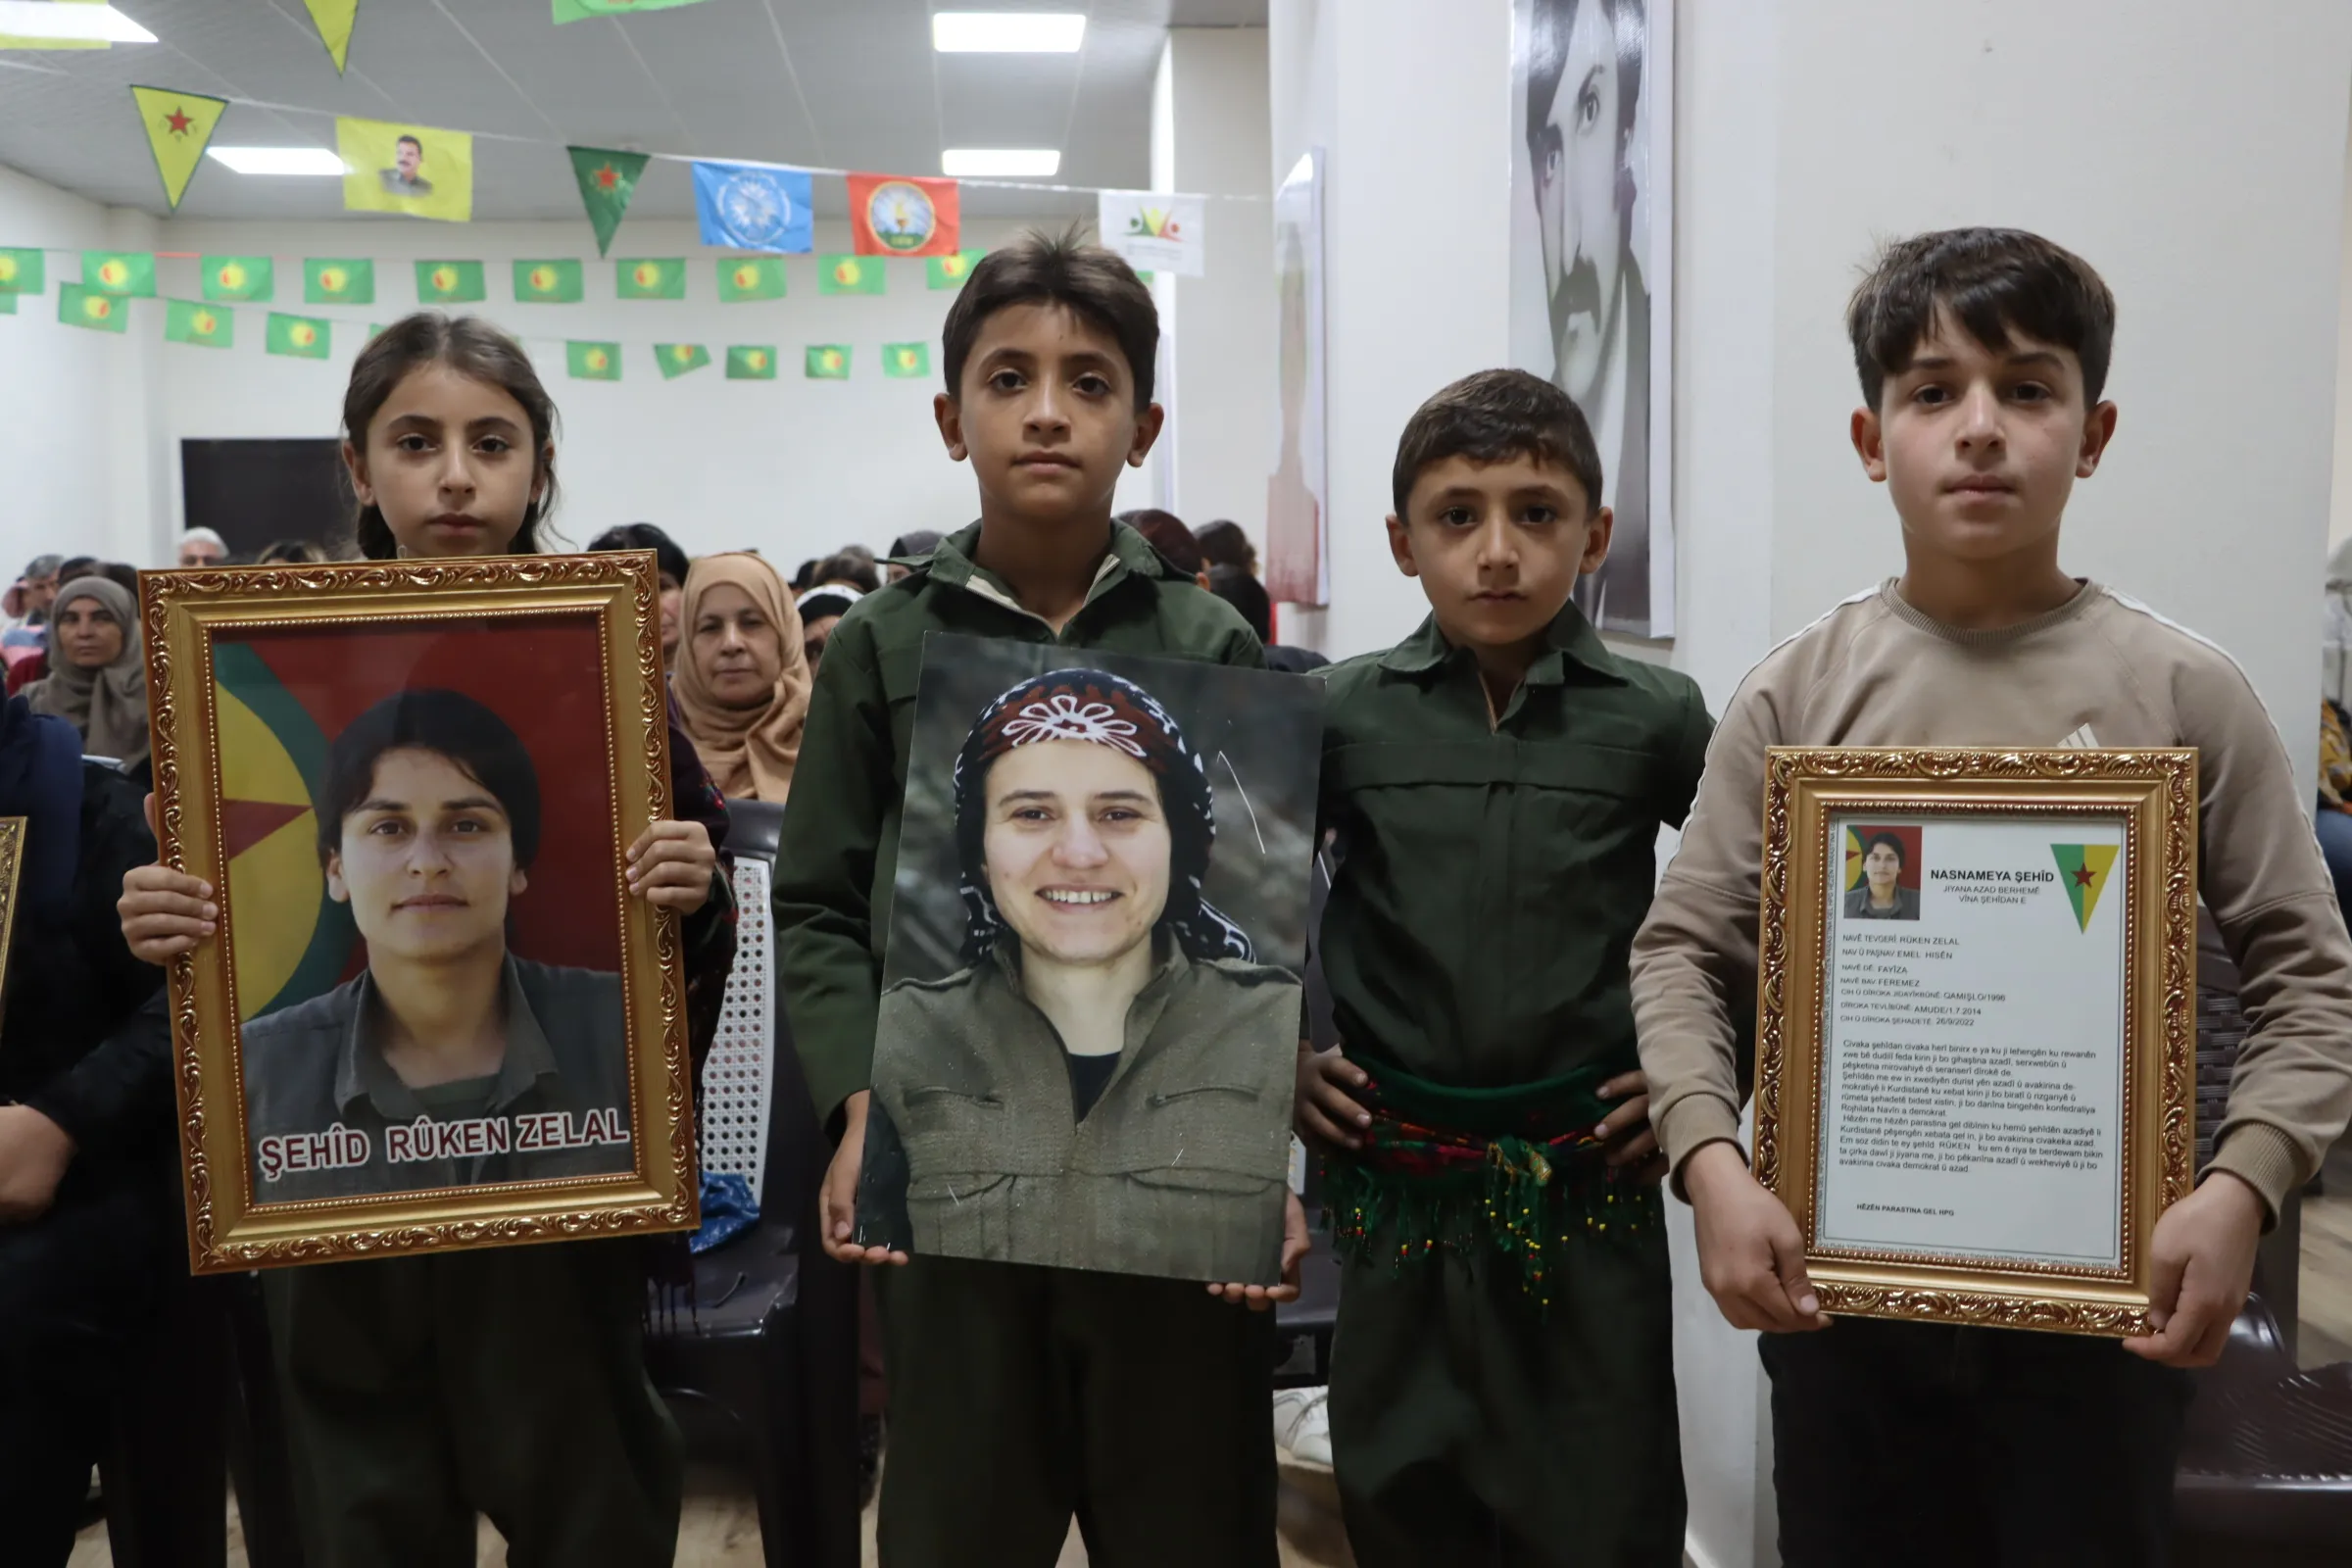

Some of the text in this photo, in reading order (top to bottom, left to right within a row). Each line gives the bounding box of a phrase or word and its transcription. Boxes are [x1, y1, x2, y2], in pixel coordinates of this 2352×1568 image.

[1931, 870, 2054, 884] NASNAMEYA ŞEHÎD
[1943, 884, 1973, 893] JIYANA
[1936, 1017, 1975, 1026] 26/9/2022
[1842, 1039, 1870, 1049] Civaka
[1904, 1042, 1930, 1051] civaka
[1990, 1046, 2001, 1054] ku
[2003, 1047, 2008, 1056] ji
[2048, 1049, 2059, 1057] ku
[1894, 1053, 1913, 1061] feda
[1914, 1054, 1932, 1062] kirin
[1933, 1054, 1937, 1063] ji
[1938, 1054, 1949, 1063] bo
[1925, 1064, 1934, 1073] di
[1904, 1074, 1912, 1083] in
[1951, 1077, 1975, 1086] durist
[2024, 1081, 2061, 1091] avakirina
[1931, 1087, 1941, 1096] ku
[1942, 1088, 1965, 1097] xebat
[1966, 1089, 1984, 1098] kirin
[1984, 1090, 1990, 1100] ji
[1991, 1090, 2003, 1099] bo
[1840, 1103, 1875, 1115] Rojhilata
[1908, 1097, 1933, 1105] bidest
[1958, 1100, 1964, 1109] ji
[1964, 1100, 1976, 1108] bo
[1910, 1117, 1947, 1129] parastina
[1948, 1120, 1962, 1130] gel
[1990, 1122, 2001, 1131] ku
[259, 1107, 630, 1182] ŞEHÎD RÛKEN ZELAL
[1924, 1129, 1951, 1139] xebata
[1952, 1131, 1966, 1141] gel
[1979, 1133, 1984, 1143] ji
[1984, 1133, 1996, 1142] bo
[1996, 1134, 2034, 1144] avakirina
[2035, 1136, 2072, 1147] civakeka
[1839, 1135, 1854, 1144] Em
[1870, 1137, 1890, 1146] didin
[1890, 1138, 1899, 1147] te
[1978, 1144, 1988, 1152] ku
[2011, 1146, 2028, 1156] riya
[2029, 1147, 2037, 1155] te
[2038, 1148, 2082, 1158] berdewam
[2083, 1151, 2103, 1159] bikin
[1838, 1156, 1874, 1166] avakirina
[1876, 1159, 1901, 1168] civaka
[1902, 1161, 1940, 1171] demokrat
[1889, 1149, 1895, 1158] ji
[1895, 1150, 1920, 1160] jiyana
[1937, 1152, 1943, 1161] ji
[1944, 1152, 1956, 1161] bo
[2080, 1161, 2085, 1171] ji
[2086, 1161, 2098, 1170] bo
[1882, 1205, 1922, 1214] PARASTINA
